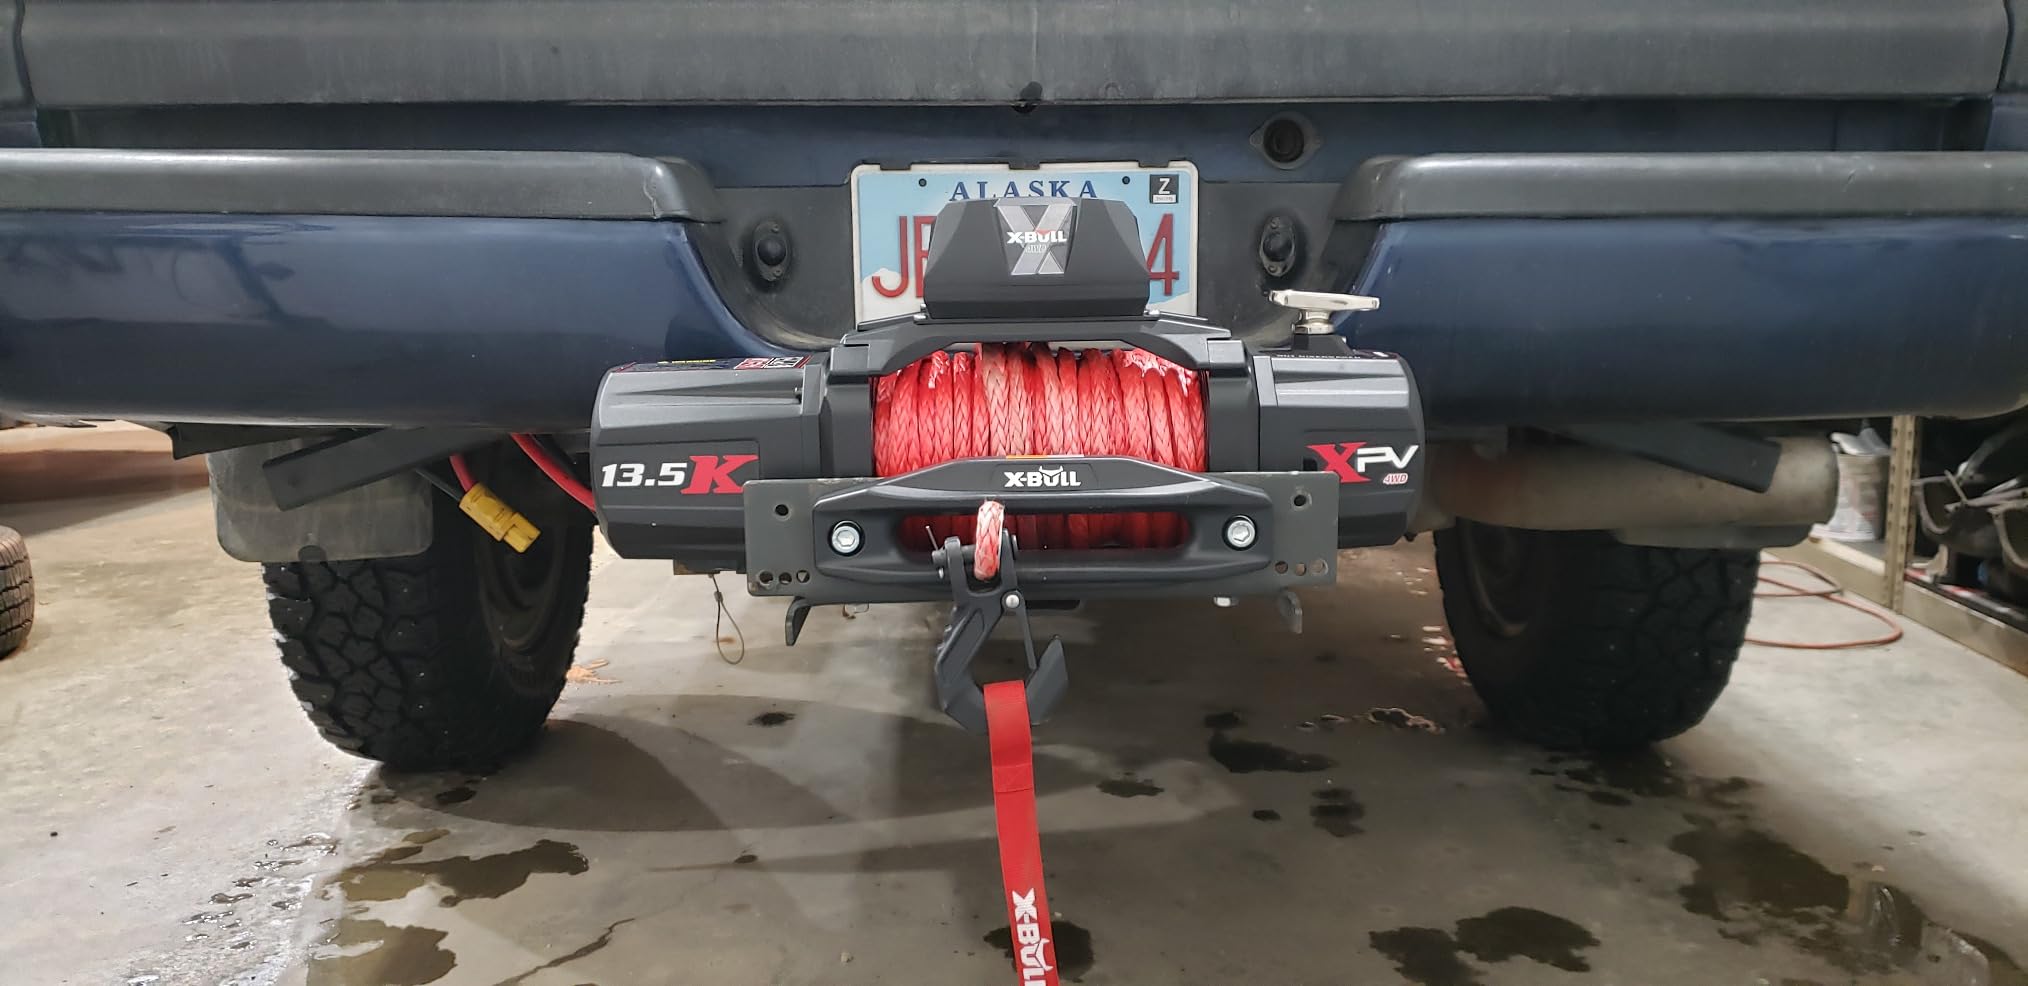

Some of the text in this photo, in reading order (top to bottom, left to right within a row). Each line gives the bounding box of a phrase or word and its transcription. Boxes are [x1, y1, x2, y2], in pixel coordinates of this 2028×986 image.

[949, 180, 1098, 201] ALASKA
[1158, 177, 1170, 194] Z
[1006, 230, 1068, 244] X-BULL
[1305, 442, 1419, 483] XPV
[601, 455, 759, 495] 13.5K
[1003, 466, 1082, 487] X-BULL
[1383, 473, 1409, 485] 4WD
